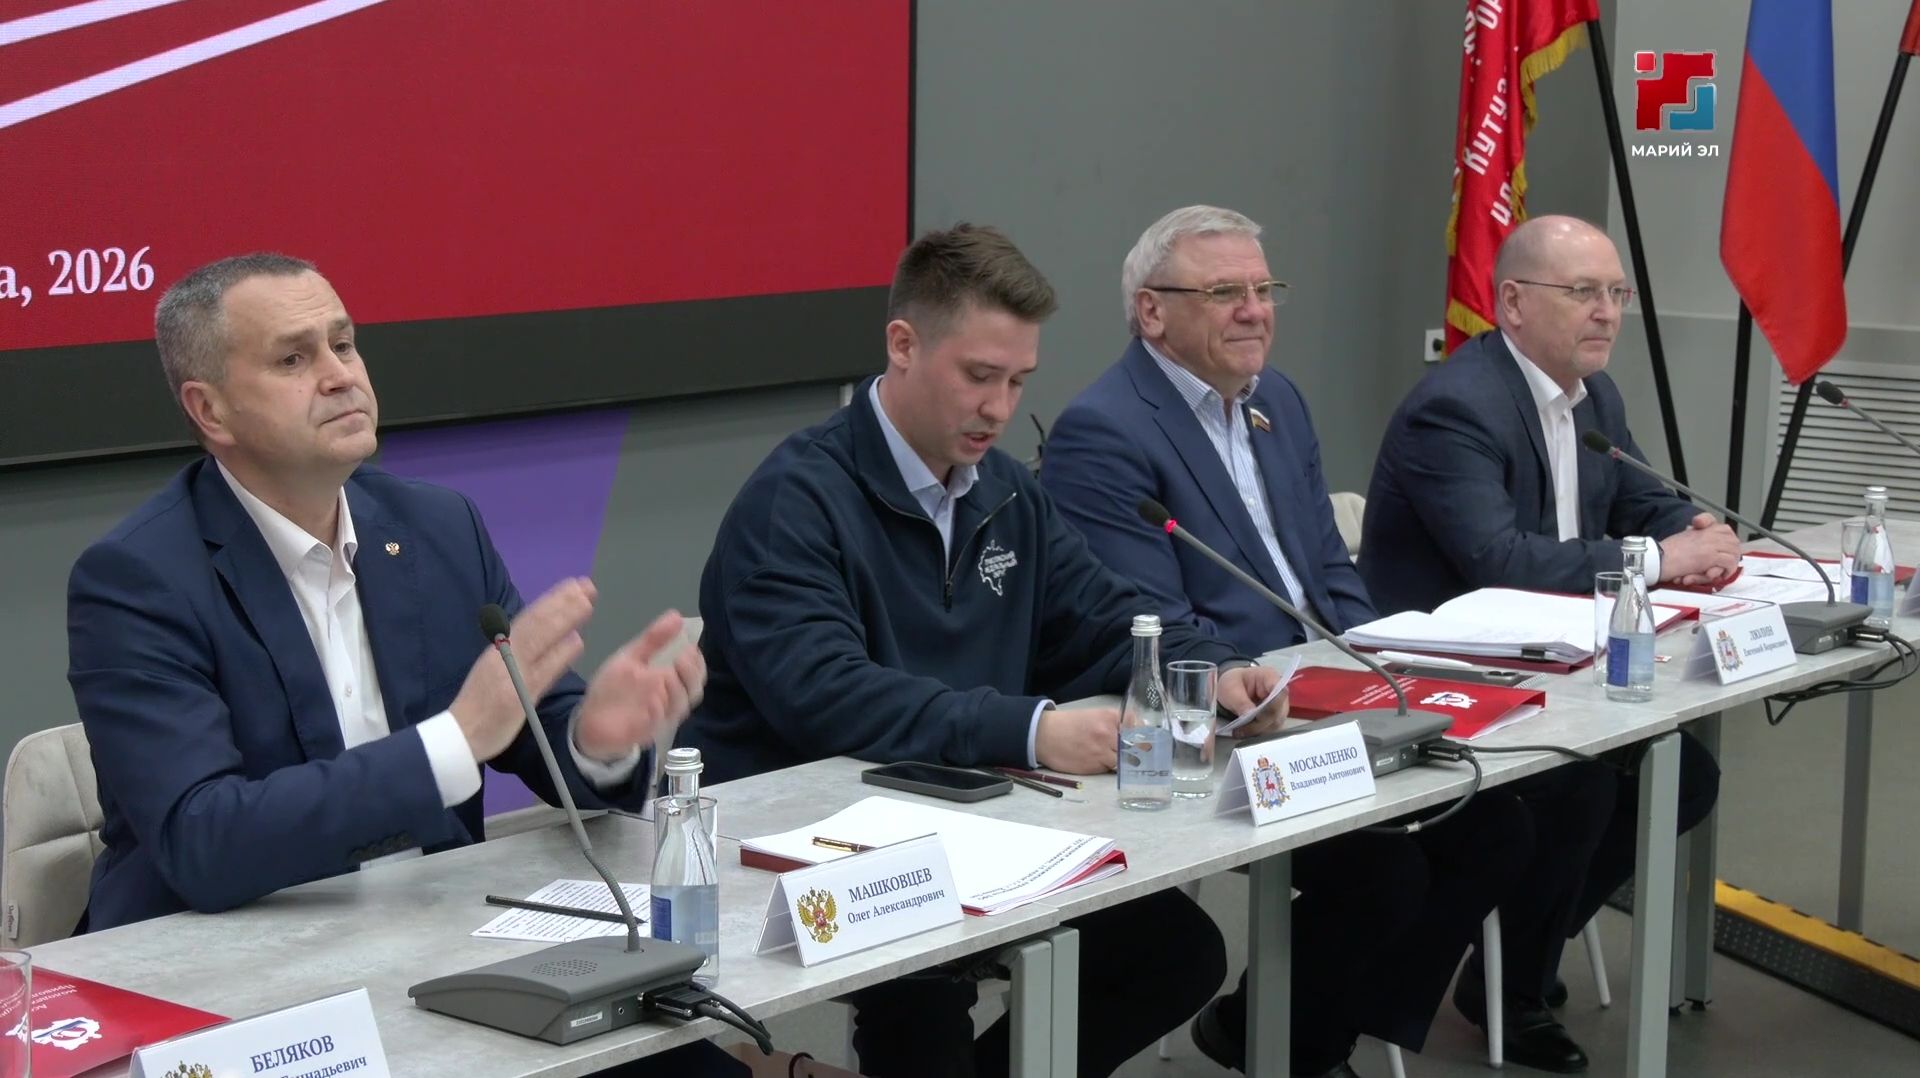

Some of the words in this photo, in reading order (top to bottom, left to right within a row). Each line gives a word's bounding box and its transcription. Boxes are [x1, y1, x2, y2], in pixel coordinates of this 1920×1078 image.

[48, 246, 155, 296] 2026
[1288, 746, 1358, 775] МОСКАЛЕНКО
[1290, 775, 1327, 791] Владимир
[848, 867, 933, 903] МАШКОВЦЕВ
[847, 910, 871, 924] Олег
[873, 889, 946, 918] Александрович
[250, 1034, 335, 1074] БЕЛЯКОВ
[280, 1056, 367, 1078] надьевич
